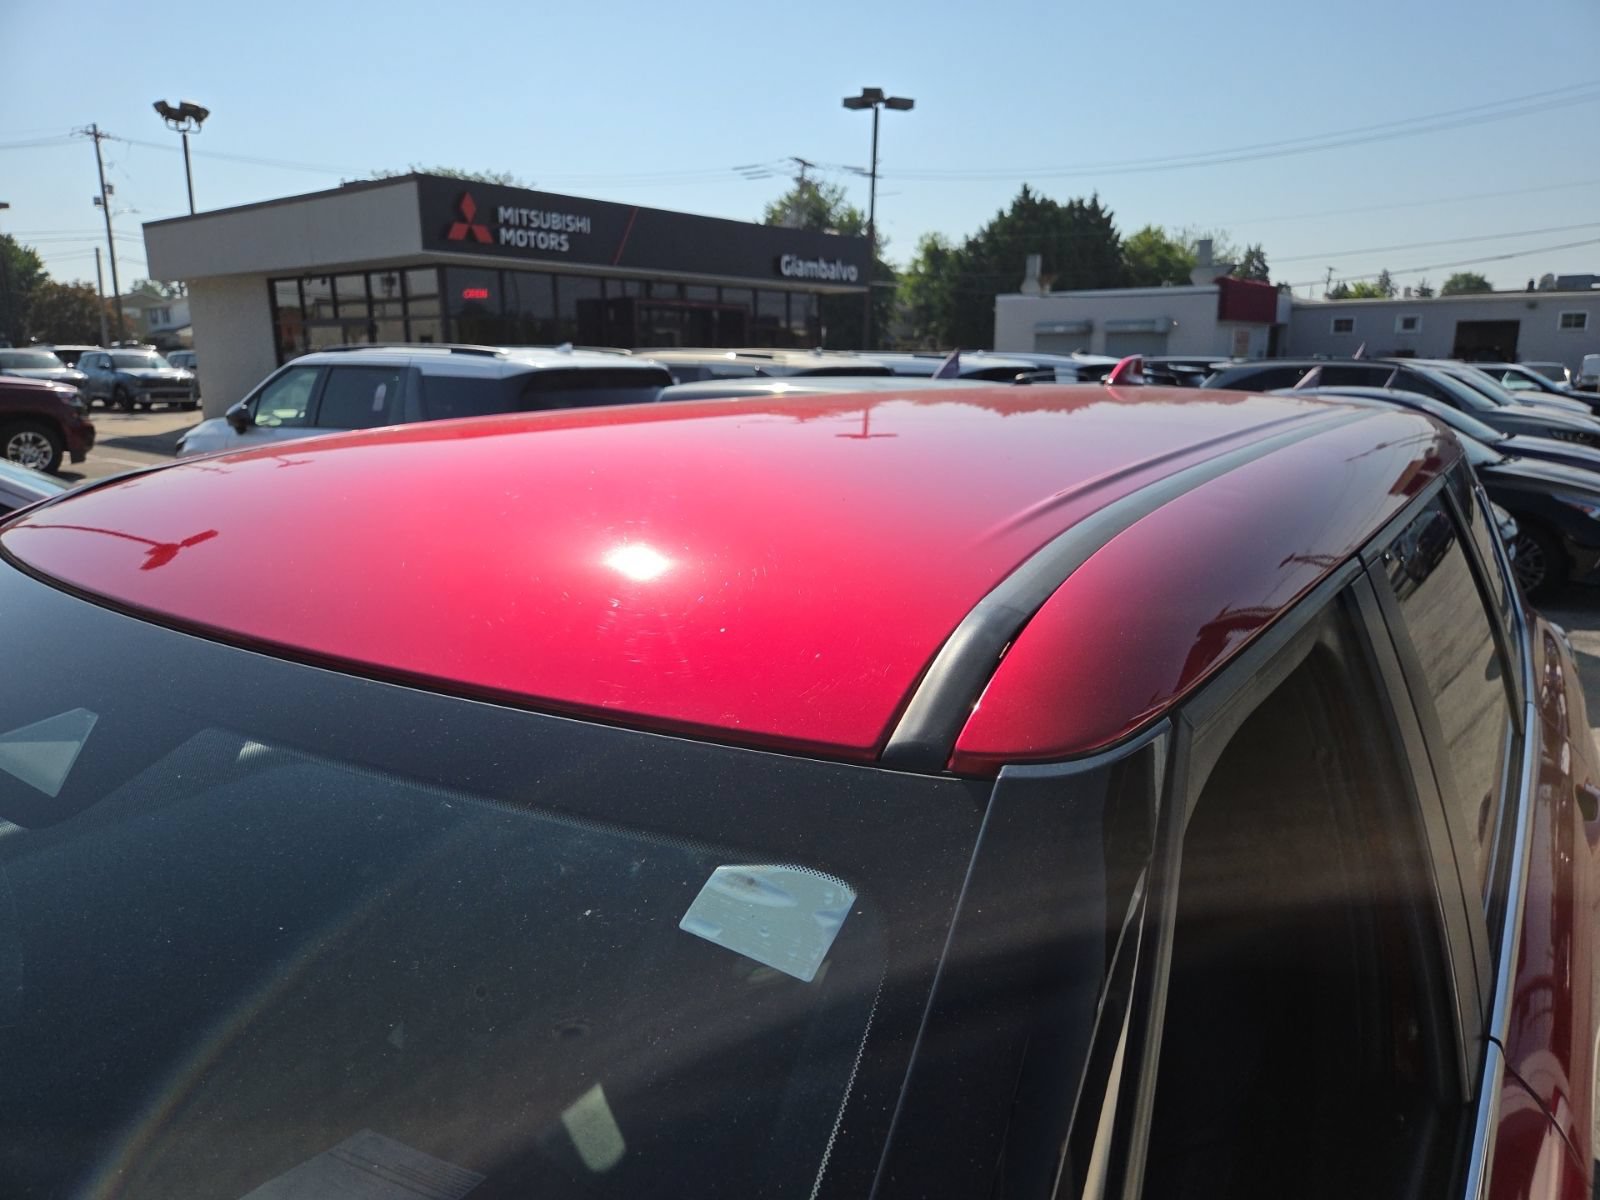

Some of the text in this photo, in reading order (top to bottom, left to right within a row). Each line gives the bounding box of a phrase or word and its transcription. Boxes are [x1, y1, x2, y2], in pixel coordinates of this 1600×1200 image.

[498, 206, 591, 234] MITSUBISHI
[500, 227, 569, 252] MOTORS
[781, 254, 858, 282] Giambalvo
[463, 288, 488, 299] OPEN
